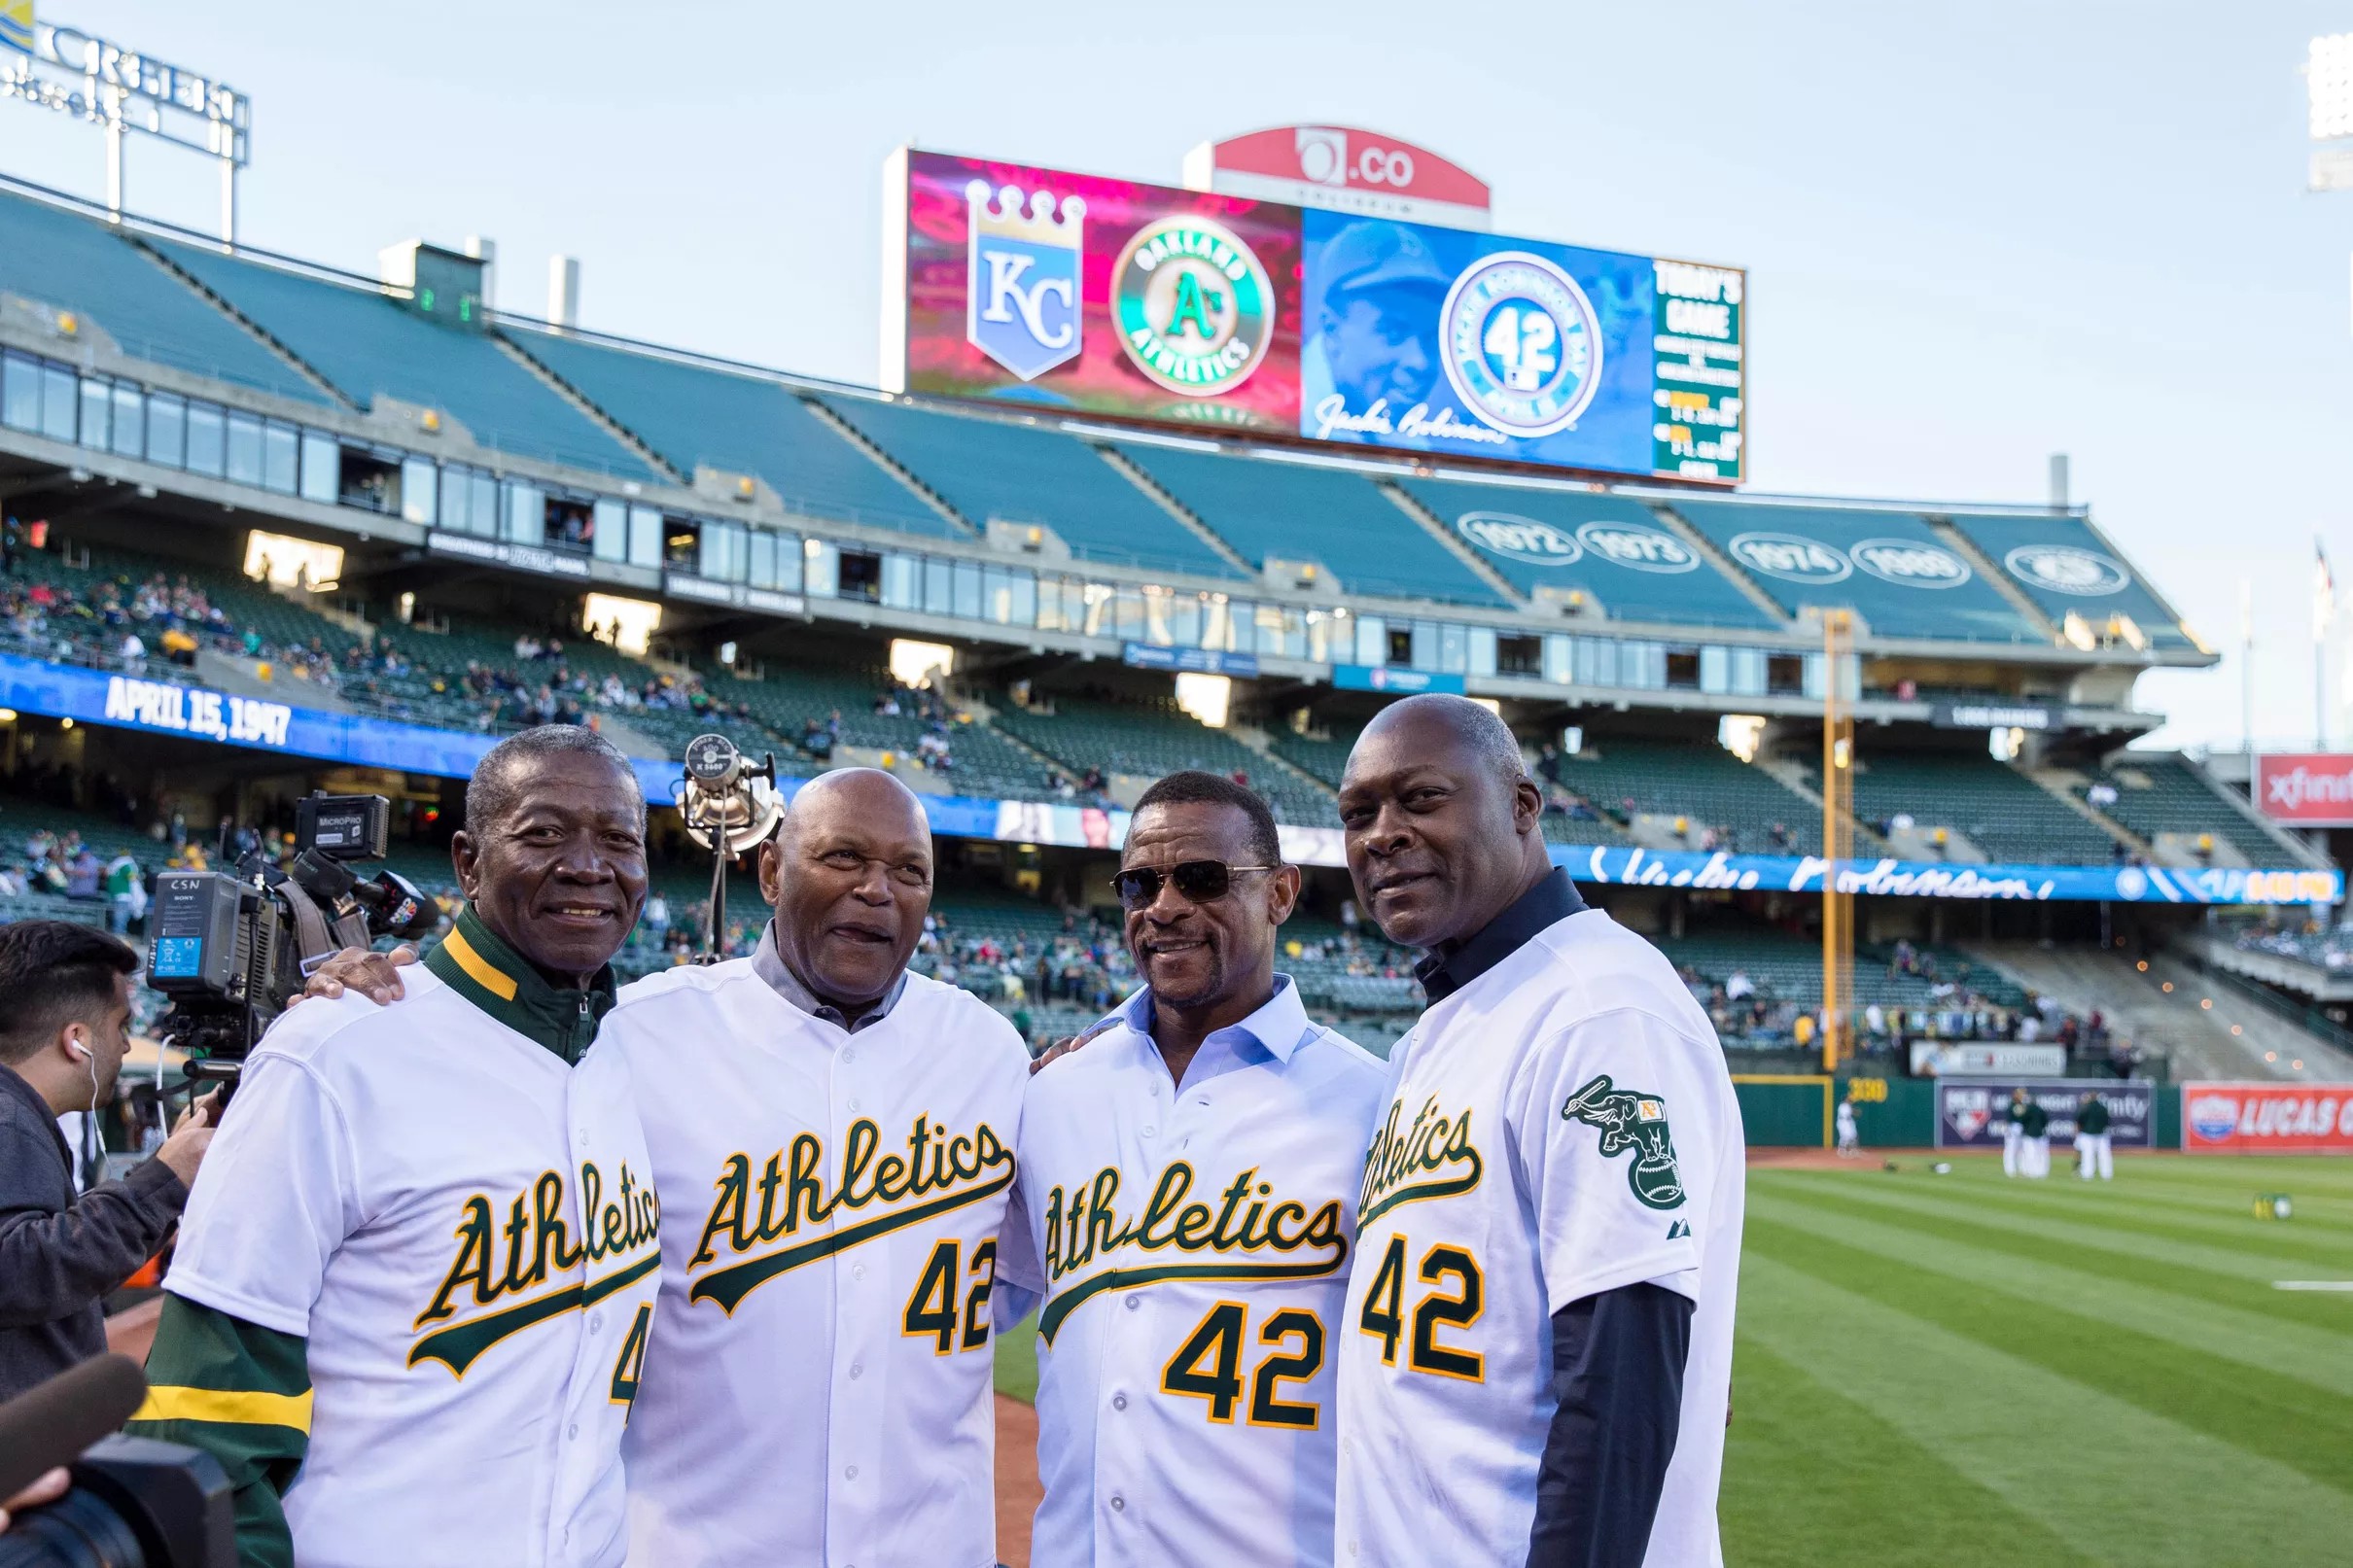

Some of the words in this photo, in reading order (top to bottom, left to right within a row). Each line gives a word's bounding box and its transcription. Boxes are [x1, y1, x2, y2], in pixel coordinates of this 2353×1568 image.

[1135, 229, 1247, 281] OAKLAND
[982, 250, 1073, 348] KC
[1131, 328, 1250, 382] ATHLETICS
[1484, 306, 1556, 372] 42
[1471, 520, 1571, 554] 1972
[1589, 529, 1688, 563] 1973
[1742, 541, 1841, 573] 1974
[105, 677, 187, 729] APRIL
[189, 689, 228, 742] 15,
[228, 697, 291, 746] 1947
[2267, 765, 2353, 809] xfini
[171, 880, 200, 889] CSN
[2237, 1097, 2339, 1137] LUCAS
[686, 1110, 1018, 1275] Athletics
[1045, 1159, 1350, 1297] Athletics
[900, 1237, 998, 1357] 42
[1359, 1233, 1485, 1384] 42
[1159, 1299, 1327, 1431] 42
